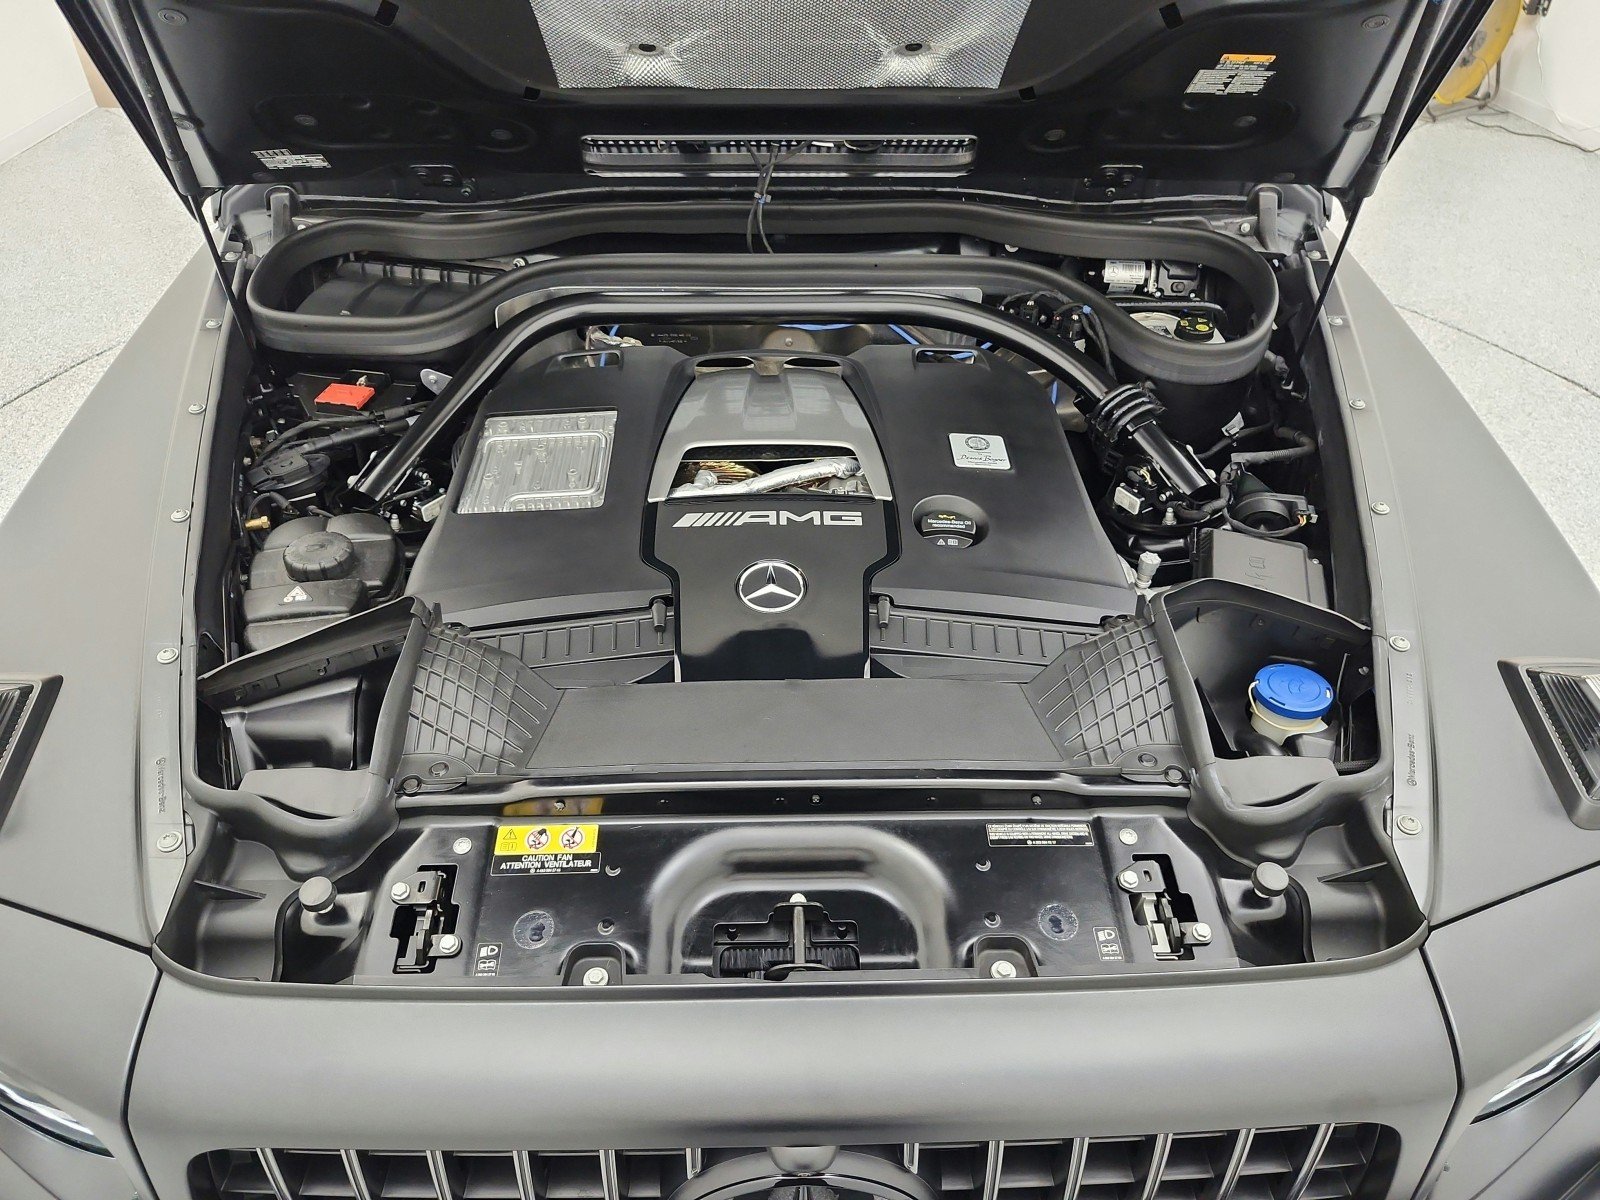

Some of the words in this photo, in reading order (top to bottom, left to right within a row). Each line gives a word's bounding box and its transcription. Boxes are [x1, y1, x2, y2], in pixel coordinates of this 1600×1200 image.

[733, 510, 863, 526] AMG
[521, 854, 555, 862] CAUTION
[557, 853, 573, 861] FAN
[500, 861, 542, 870] ATTENTION
[544, 859, 592, 868] VENTILATEUR
